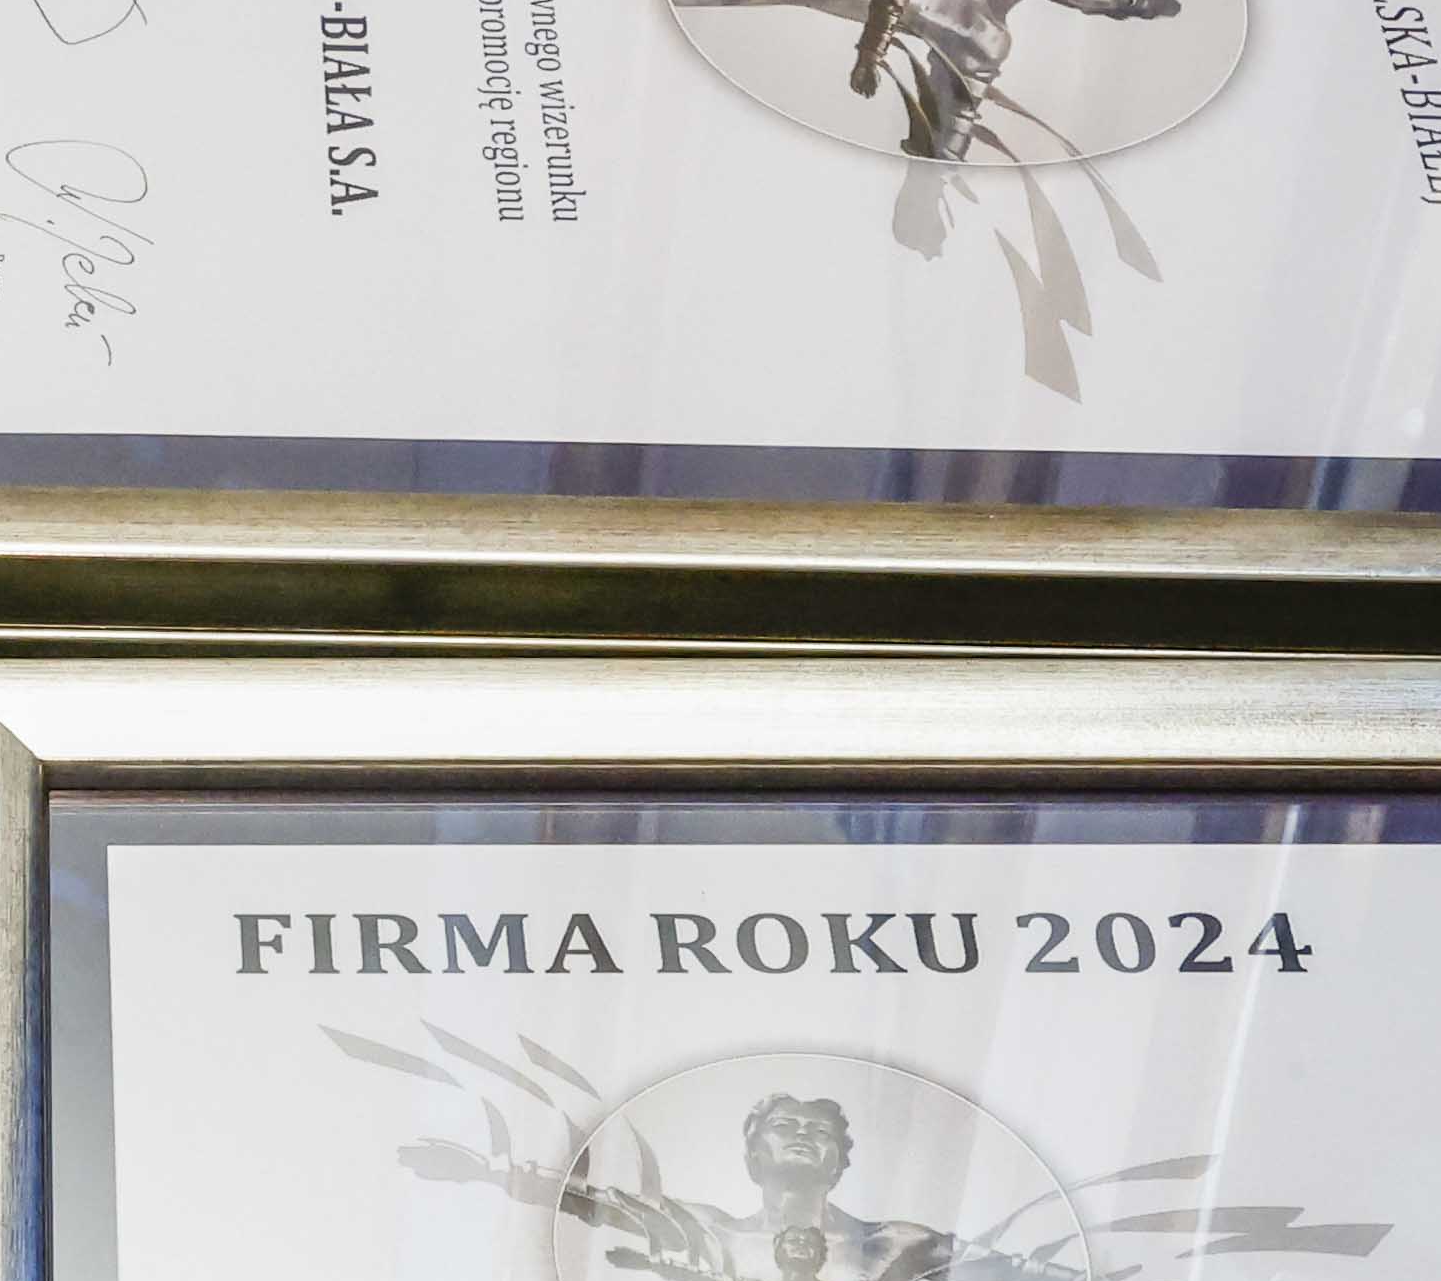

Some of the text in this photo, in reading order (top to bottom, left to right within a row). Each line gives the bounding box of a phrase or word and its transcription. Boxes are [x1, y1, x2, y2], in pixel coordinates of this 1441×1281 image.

[328, 147, 378, 215] S.A.
[483, 119, 528, 221] regionu
[540, 80, 585, 221] wizerunku
[233, 912, 1312, 974] FIRMA ROKU 2024
